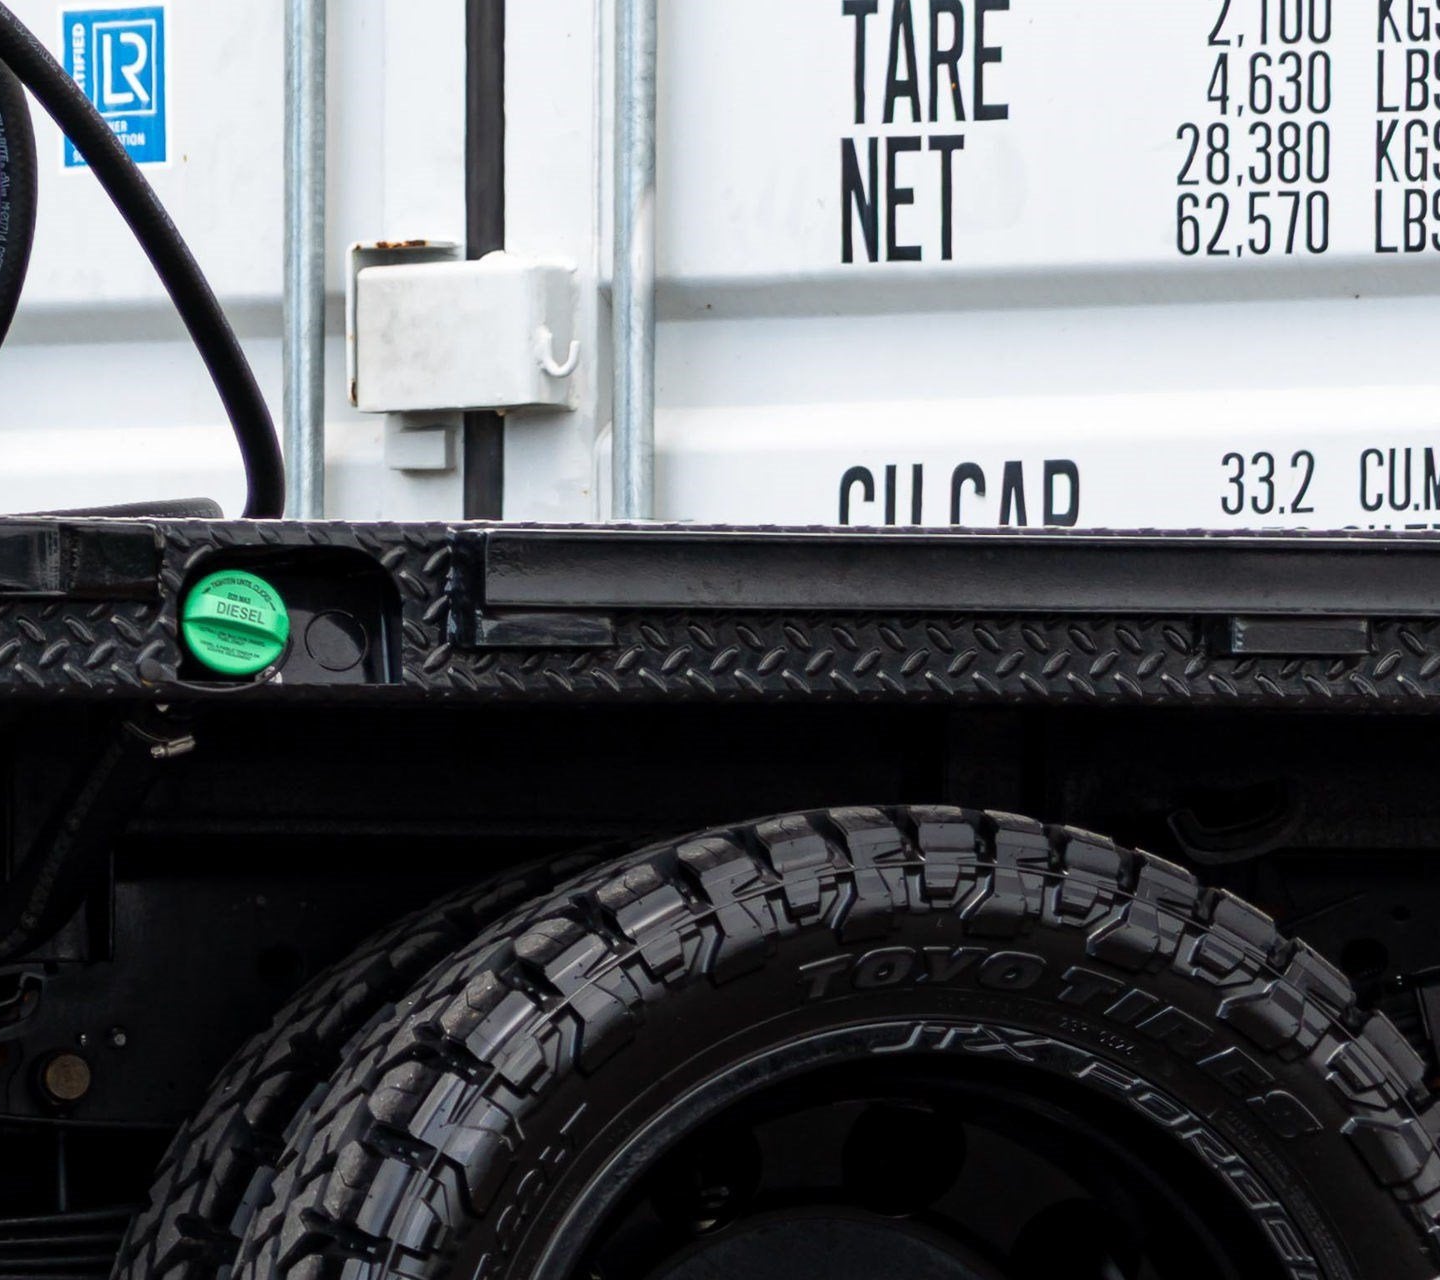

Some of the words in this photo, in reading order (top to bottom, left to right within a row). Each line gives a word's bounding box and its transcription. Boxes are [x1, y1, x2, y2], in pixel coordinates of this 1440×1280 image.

[103, 32, 150, 105] LR
[1207, 50, 1331, 117] 4,630
[841, 134, 965, 264] NET
[1176, 120, 1331, 187] 28,380
[1176, 190, 1330, 258] 62,570
[1221, 449, 1315, 516] 33.2
[216, 601, 265, 625] DIESEL
[799, 945, 1048, 1002] TOYO
[1058, 965, 1324, 1140] TIRES
